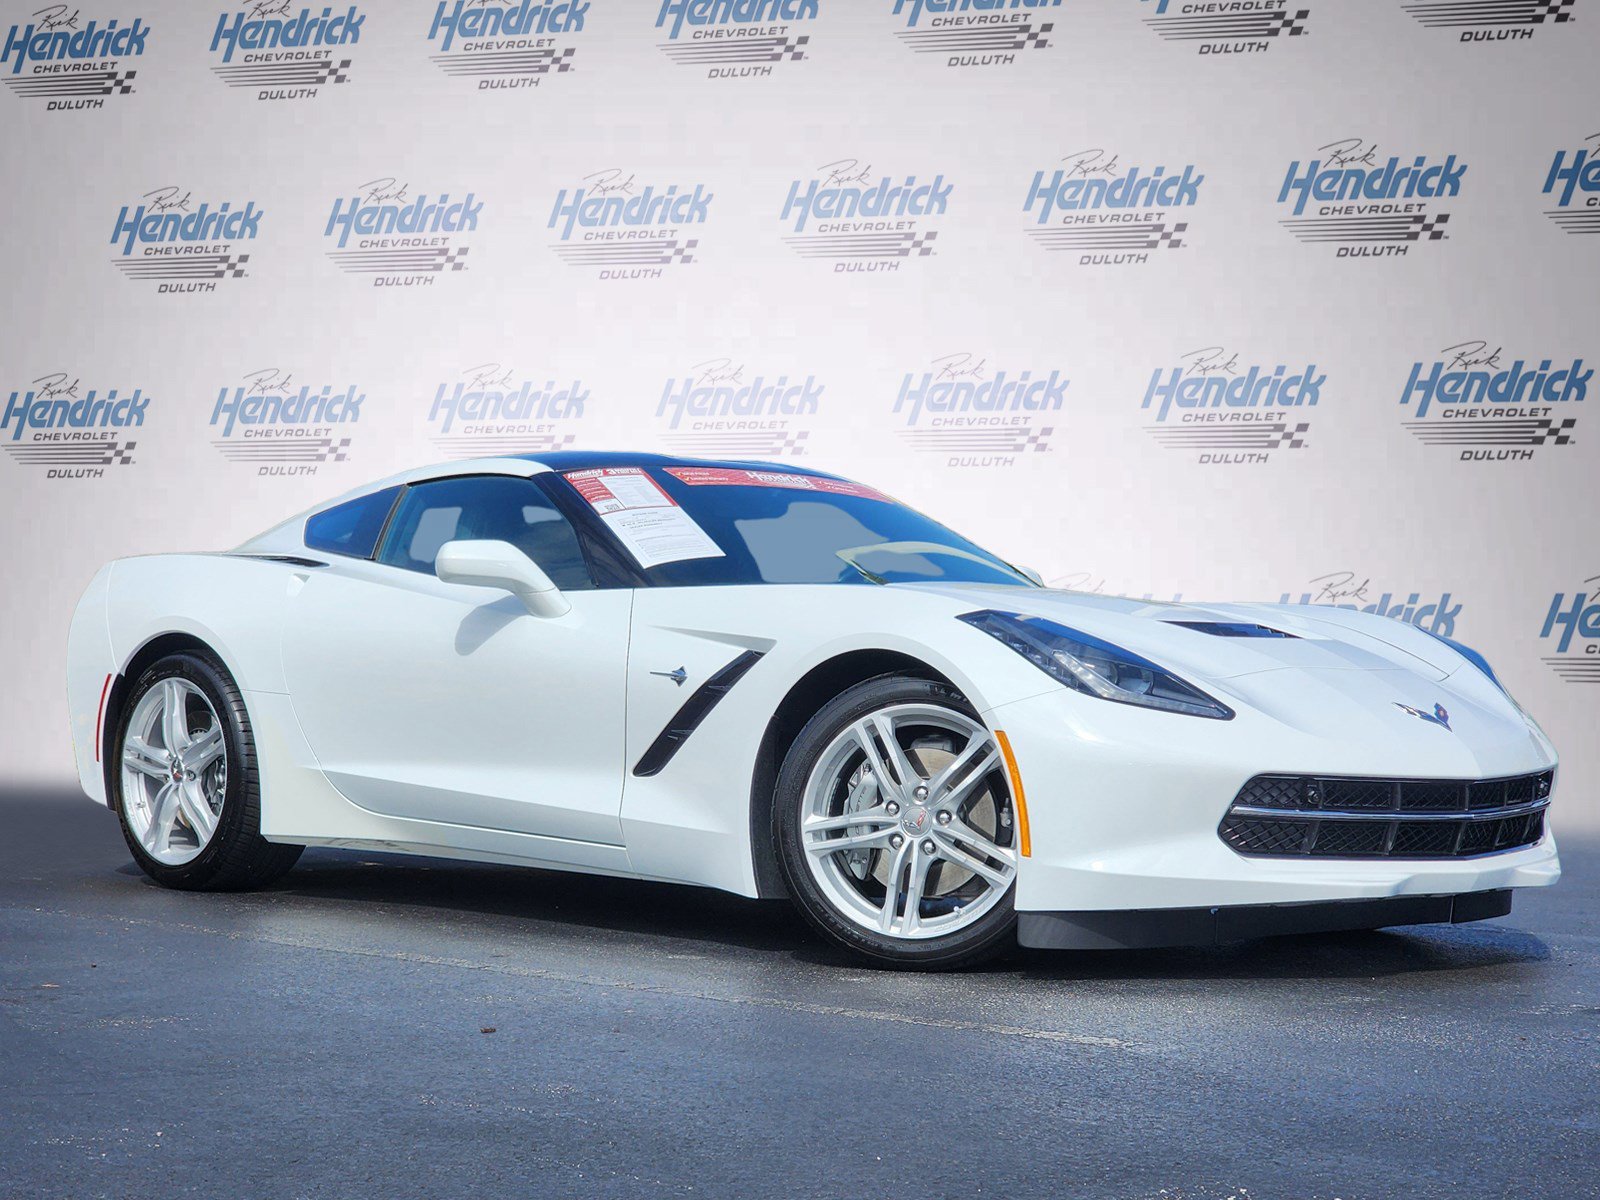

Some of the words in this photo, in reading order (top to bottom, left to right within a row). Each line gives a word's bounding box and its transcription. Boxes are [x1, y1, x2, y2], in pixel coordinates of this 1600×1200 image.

[1182, 0, 1286, 13] CHEVROLET
[427, 0, 591, 51] Hendrick
[931, 13, 1032, 27] CHEVROLET
[209, 6, 366, 63] Hendrick
[692, 26, 788, 39] CHEVROLET
[1460, 28, 1534, 42] DULUTH
[0, 18, 150, 74] Hendrick
[463, 38, 556, 51] CHEVROLET
[1199, 41, 1269, 55] DULUTH
[244, 50, 332, 63] CHEVROLET
[947, 54, 1015, 67] DULUTH
[33, 61, 118, 74] CHEVROLET
[708, 66, 772, 79] DULUTH
[478, 77, 540, 90] DULUTH
[258, 88, 318, 100] DULUTH
[47, 99, 104, 111] DULUTH
[1277, 155, 1468, 216] Hendrick
[1023, 165, 1205, 224] Hendrick
[779, 175, 954, 233] Hendrick
[1319, 203, 1426, 216] CHEVROLET
[547, 184, 714, 240] Hendrick
[1063, 212, 1165, 224] CHEVROLET
[324, 193, 484, 248] Hendrick
[818, 221, 916, 233] CHEVROLET
[110, 201, 264, 256] Hendrick
[584, 229, 678, 241] CHEVROLET
[359, 237, 449, 248] CHEVROLET
[144, 245, 230, 256] CHEVROLET
[1336, 245, 1409, 258] DULUTH
[1079, 253, 1148, 266] DULUTH
[834, 261, 900, 273] DULUTH
[599, 268, 662, 280] DULUTH
[158, 282, 216, 293] DULUTH
[373, 276, 434, 287] DULUTH
[1141, 365, 1327, 422] Hendrick
[1400, 359, 1594, 418] Hendrick
[655, 375, 825, 430] Hendrick
[892, 370, 1070, 426] Hendrick
[209, 385, 366, 437] Hendrick
[427, 380, 590, 433] Hendrick
[1442, 407, 1552, 418] CHEVROLET
[0, 389, 150, 440] Hendrick
[1182, 412, 1286, 422] CHEVROLET
[693, 420, 788, 430] CHEVROLET
[932, 416, 1032, 427] CHEVROLET
[244, 428, 332, 438] CHEVROLET
[464, 424, 555, 434] CHEVROLET
[33, 432, 118, 441] CHEVROLET
[948, 456, 1015, 467] DULUTH
[1199, 453, 1269, 464] DULUTH
[1460, 450, 1534, 461] DULUTH
[47, 469, 104, 479] DULUTH
[258, 466, 318, 476] DULUTH
